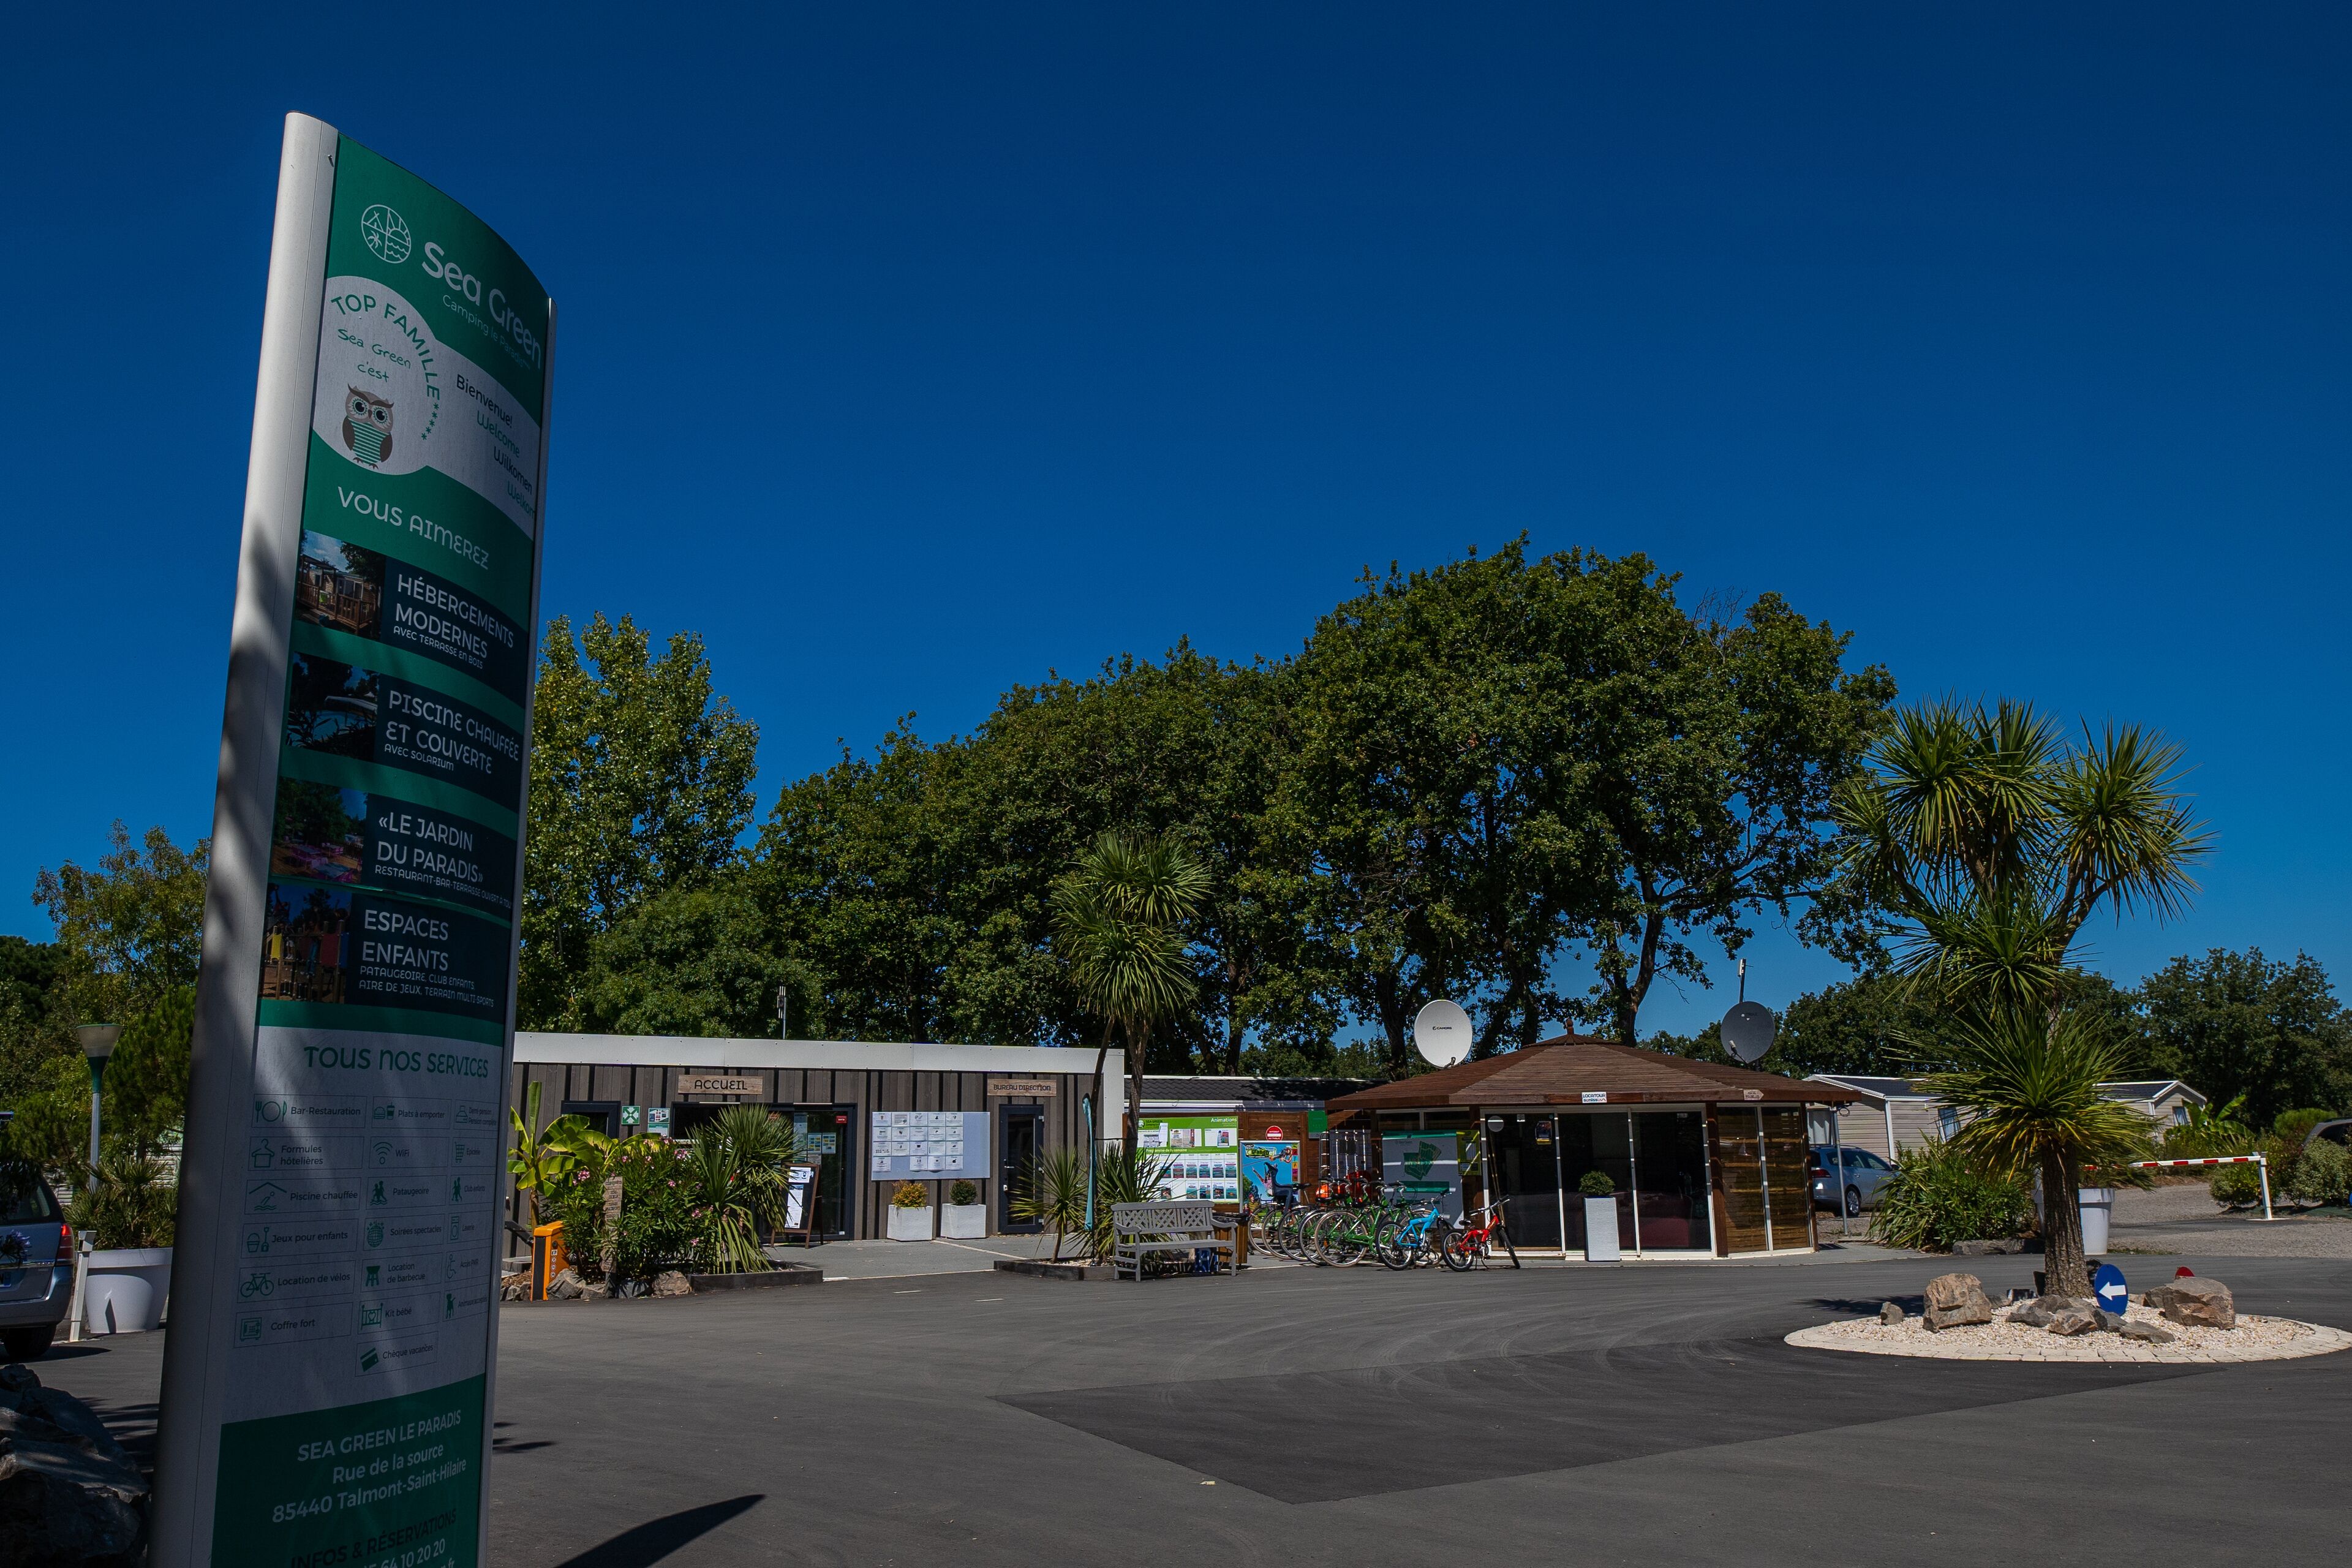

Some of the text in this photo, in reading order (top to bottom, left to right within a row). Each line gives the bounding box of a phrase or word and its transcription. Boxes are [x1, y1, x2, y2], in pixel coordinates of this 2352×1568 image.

[421, 241, 541, 369] Sea Green
[443, 295, 489, 336] Camping
[491, 327, 498, 341] le
[331, 294, 440, 401] TOP FAMILLE
[337, 328, 411, 369] Sea Green
[357, 361, 390, 382] c'est
[456, 374, 513, 428] Bienvenue!
[477, 410, 520, 458] Welcome
[494, 446, 532, 495] Wilkomen
[337, 486, 489, 570] VOUS AIMEREZ
[397, 573, 514, 649] HÉBERGEMENTS
[395, 603, 488, 659] MODERNES
[393, 626, 418, 641] AVEC
[419, 633, 457, 657] TERRASSE
[469, 654, 483, 669] BOIS
[388, 690, 519, 761] PISCINE CHAUFFÉE
[384, 743, 454, 772] AVEC SOLARIUM
[385, 720, 492, 774] ET COUVERTE
[415, 819, 473, 852] JARDIN
[377, 840, 484, 883] DU PARADIS»
[364, 909, 449, 941] ESPACES
[361, 941, 449, 971] ENFANTS
[358, 980, 495, 1008] AIRE DE JEUX, TERRAIN MULTI-SPORTS
[429, 973, 447, 985] CLUB
[303, 1046, 371, 1069] TOUS
[426, 1052, 489, 1079] SERVICES
[694, 1079, 748, 1090] ACCUEIL
[290, 1106, 361, 1116] Bar-Restauration
[398, 1109, 413, 1118] Plats
[420, 1111, 445, 1120] emporter
[280, 1156, 323, 1166] hôtelières
[281, 1145, 322, 1153] Formules
[395, 1148, 410, 1158] WiFi
[290, 1191, 358, 1201] Piscine chauffée
[393, 1187, 429, 1197] Pataugeoire
[271, 1231, 349, 1243] Jeux pour enfants
[390, 1225, 442, 1236] Soirées spectacles
[277, 1273, 351, 1286] Location de vélos
[387, 1272, 426, 1284] de barbecue
[388, 1262, 415, 1272] Location
[270, 1318, 316, 1331] Coffre fort
[385, 1307, 412, 1318] Kit bébé
[382, 1344, 434, 1360] Chèque vacances
[297, 1409, 461, 1462] SEA GREEN LE PARADIS
[333, 1443, 444, 1485] Rue de la source
[271, 1457, 466, 1523] 85440 Talmont-Saint-Hilaire
[352, 1541, 363, 1559] &
[367, 1509, 456, 1556] RÉSERVATIONS
[401, 1551, 414, 1568] 10
[417, 1544, 431, 1564] 20
[432, 1538, 445, 1558] 20
